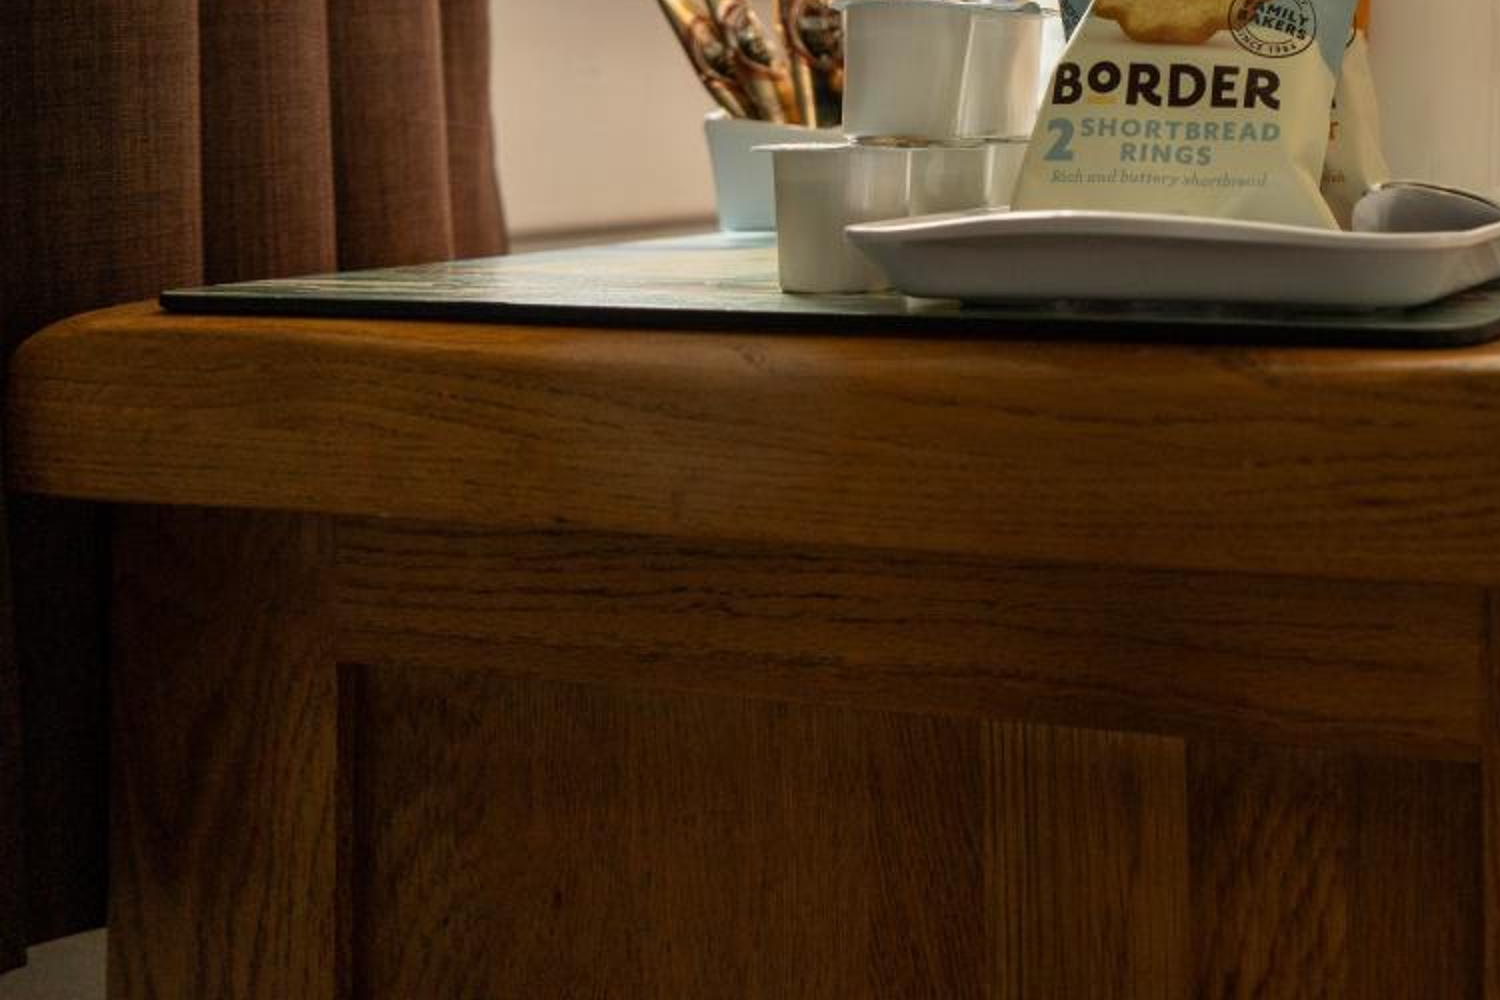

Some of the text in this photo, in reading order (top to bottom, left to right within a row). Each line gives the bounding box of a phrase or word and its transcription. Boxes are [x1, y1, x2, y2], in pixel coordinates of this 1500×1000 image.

[1237, 8, 1307, 40] BAKERS
[1051, 60, 1281, 111] BORDER
[1043, 117, 1281, 162] 2 SHORTBREAD
[1120, 142, 1213, 166] RINGS
[1050, 168, 1268, 189] Rich and buttery shortbread
